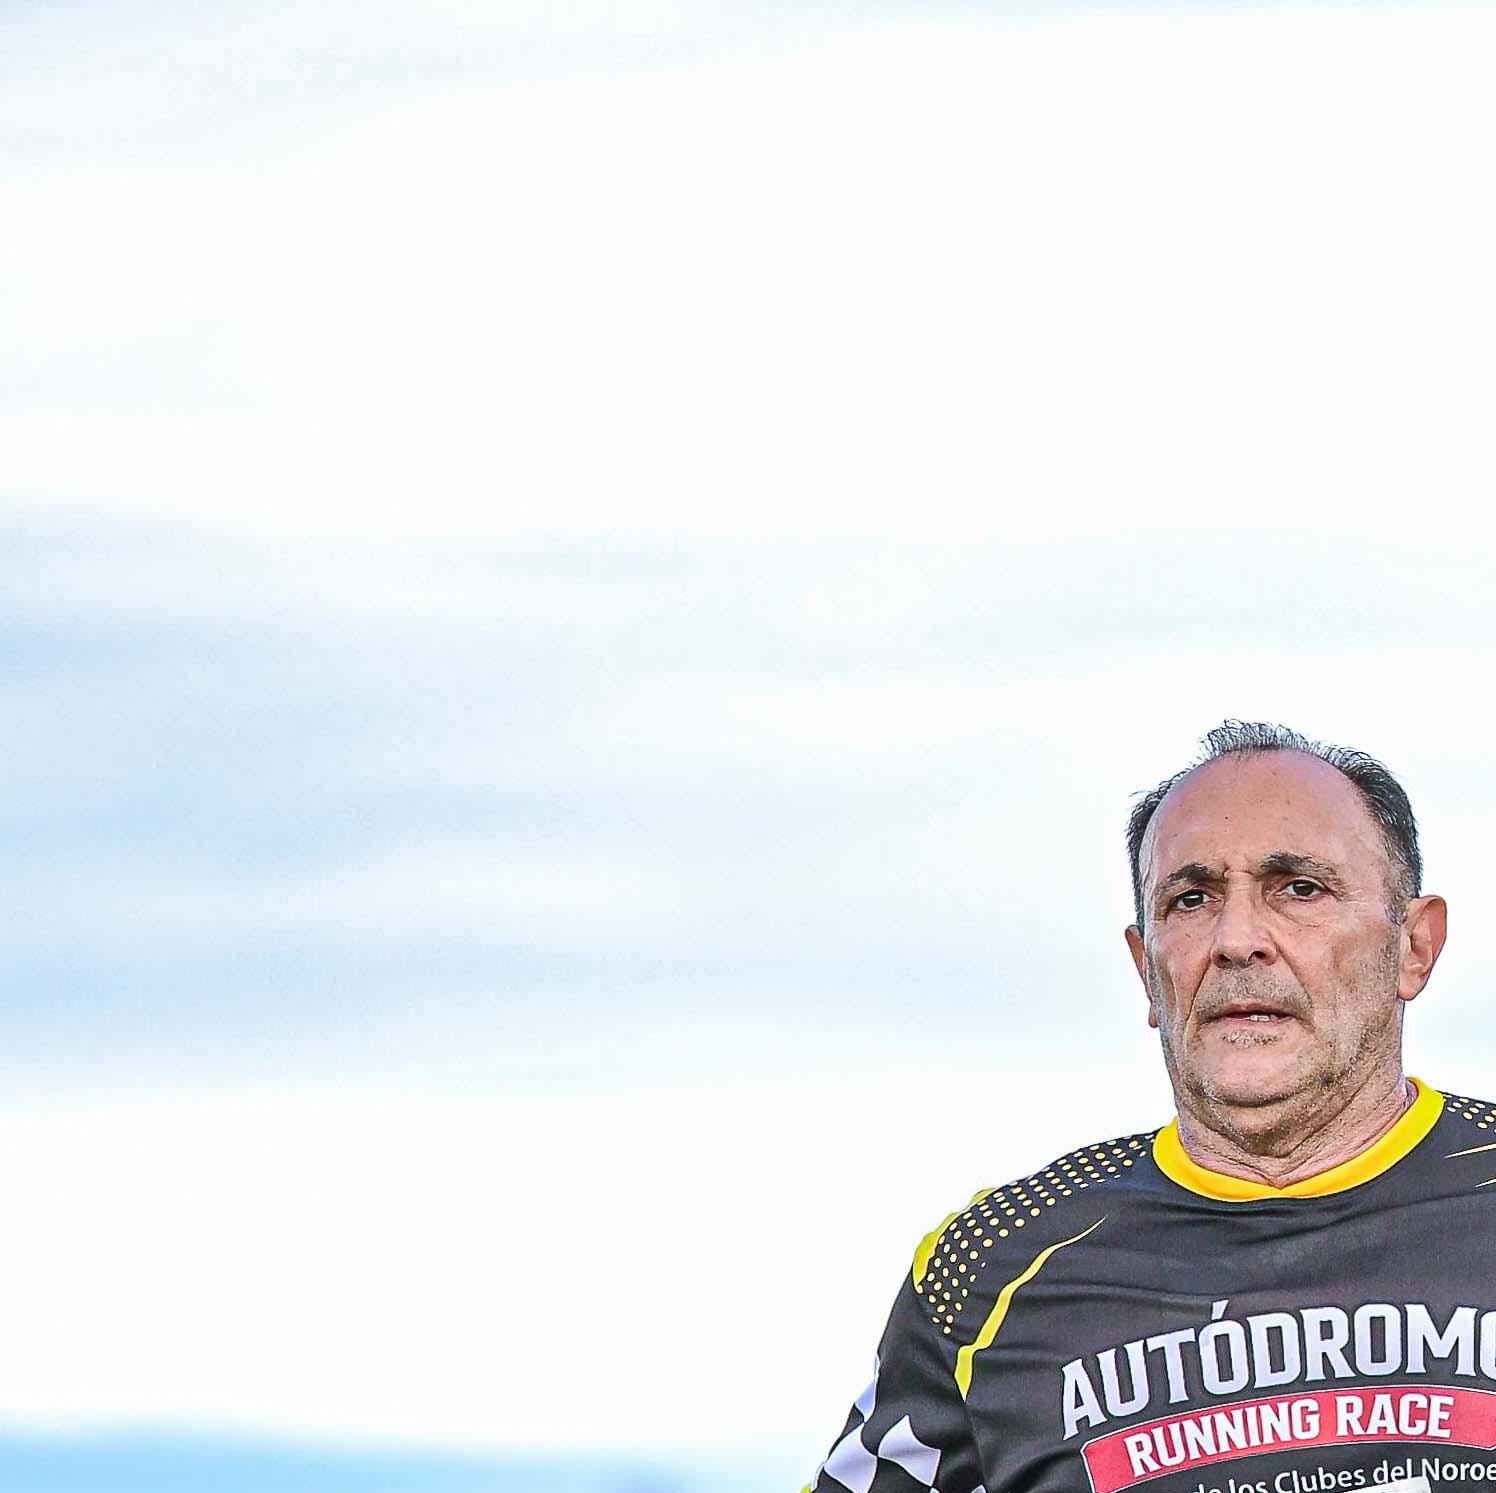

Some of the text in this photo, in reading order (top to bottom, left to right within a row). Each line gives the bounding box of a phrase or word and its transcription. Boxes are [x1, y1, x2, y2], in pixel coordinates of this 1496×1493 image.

[1123, 1393, 1454, 1477] RUNNING RACE
[1372, 1458, 1413, 1485] del
